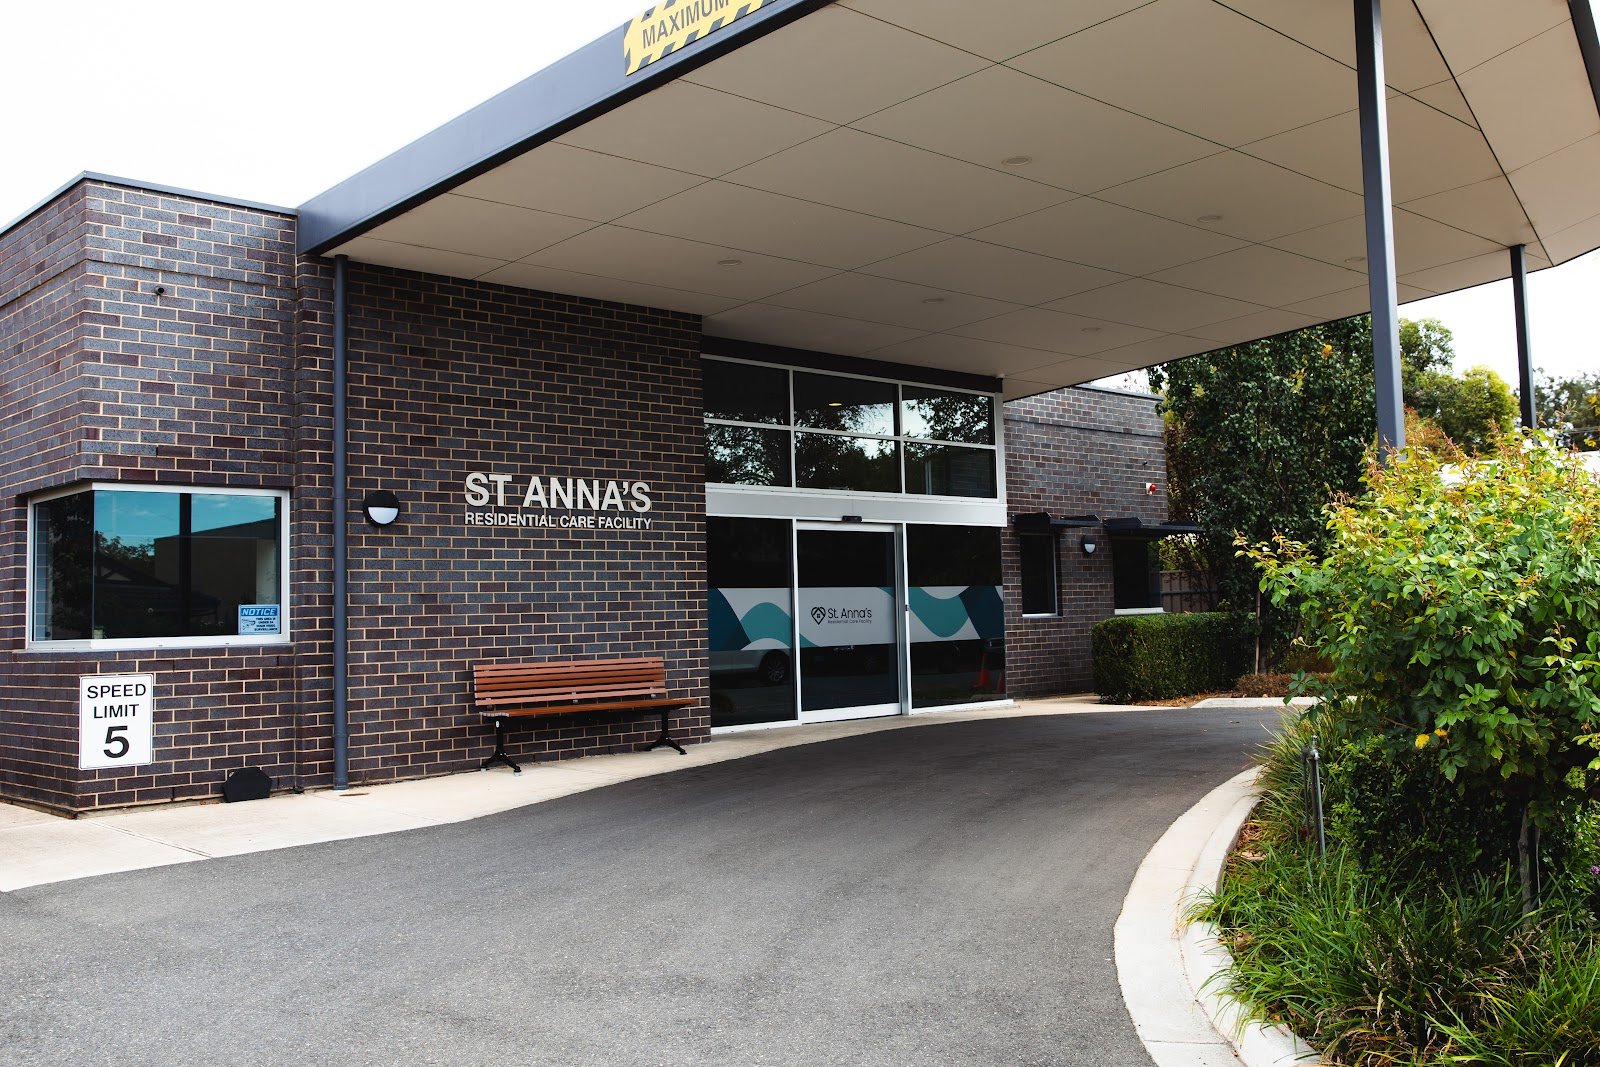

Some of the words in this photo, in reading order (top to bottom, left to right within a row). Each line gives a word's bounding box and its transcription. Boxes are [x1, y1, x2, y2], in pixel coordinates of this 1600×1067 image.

[464, 472, 513, 507] ST
[522, 475, 652, 513] ANNA'S
[464, 512, 557, 528] RESIDENTIAL
[559, 516, 595, 528] CARE
[598, 516, 652, 530] FACILITY
[242, 608, 276, 616] NOTICE
[841, 607, 872, 619] Anna's
[87, 683, 146, 699] SPEED
[93, 703, 139, 719] LIMIT
[103, 725, 130, 758] 5
